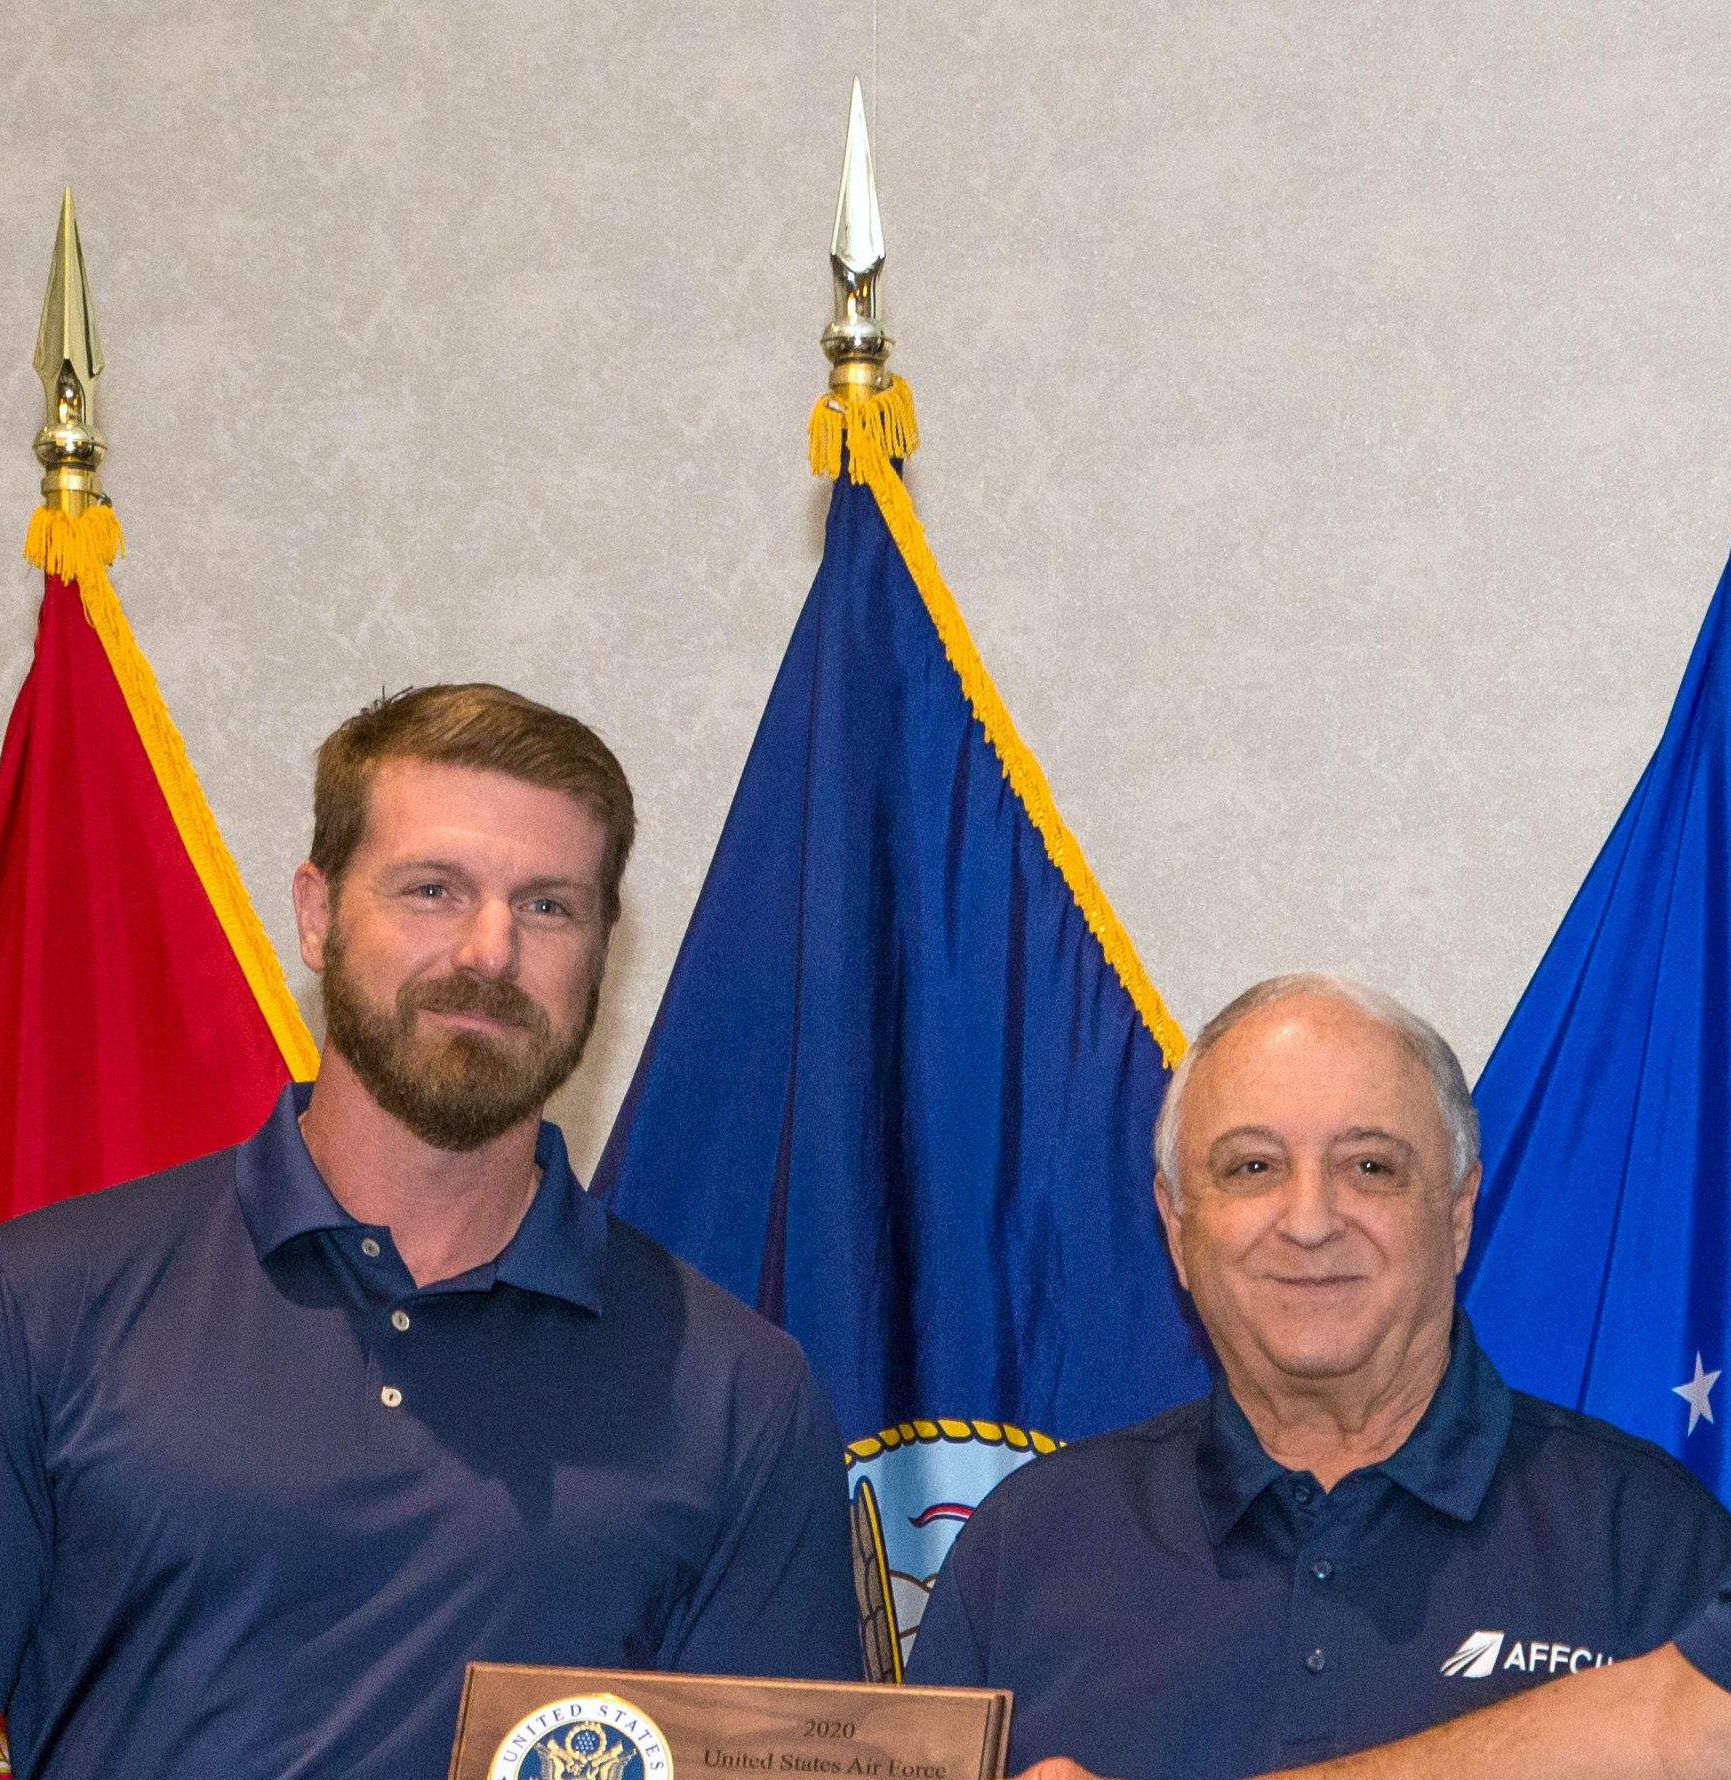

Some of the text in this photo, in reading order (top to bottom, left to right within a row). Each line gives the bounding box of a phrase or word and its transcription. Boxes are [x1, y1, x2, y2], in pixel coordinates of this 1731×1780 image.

[503, 1704, 664, 1771] UNITED STATES
[802, 1720, 856, 1740] 2020
[703, 1748, 948, 1780] United States Air Force
